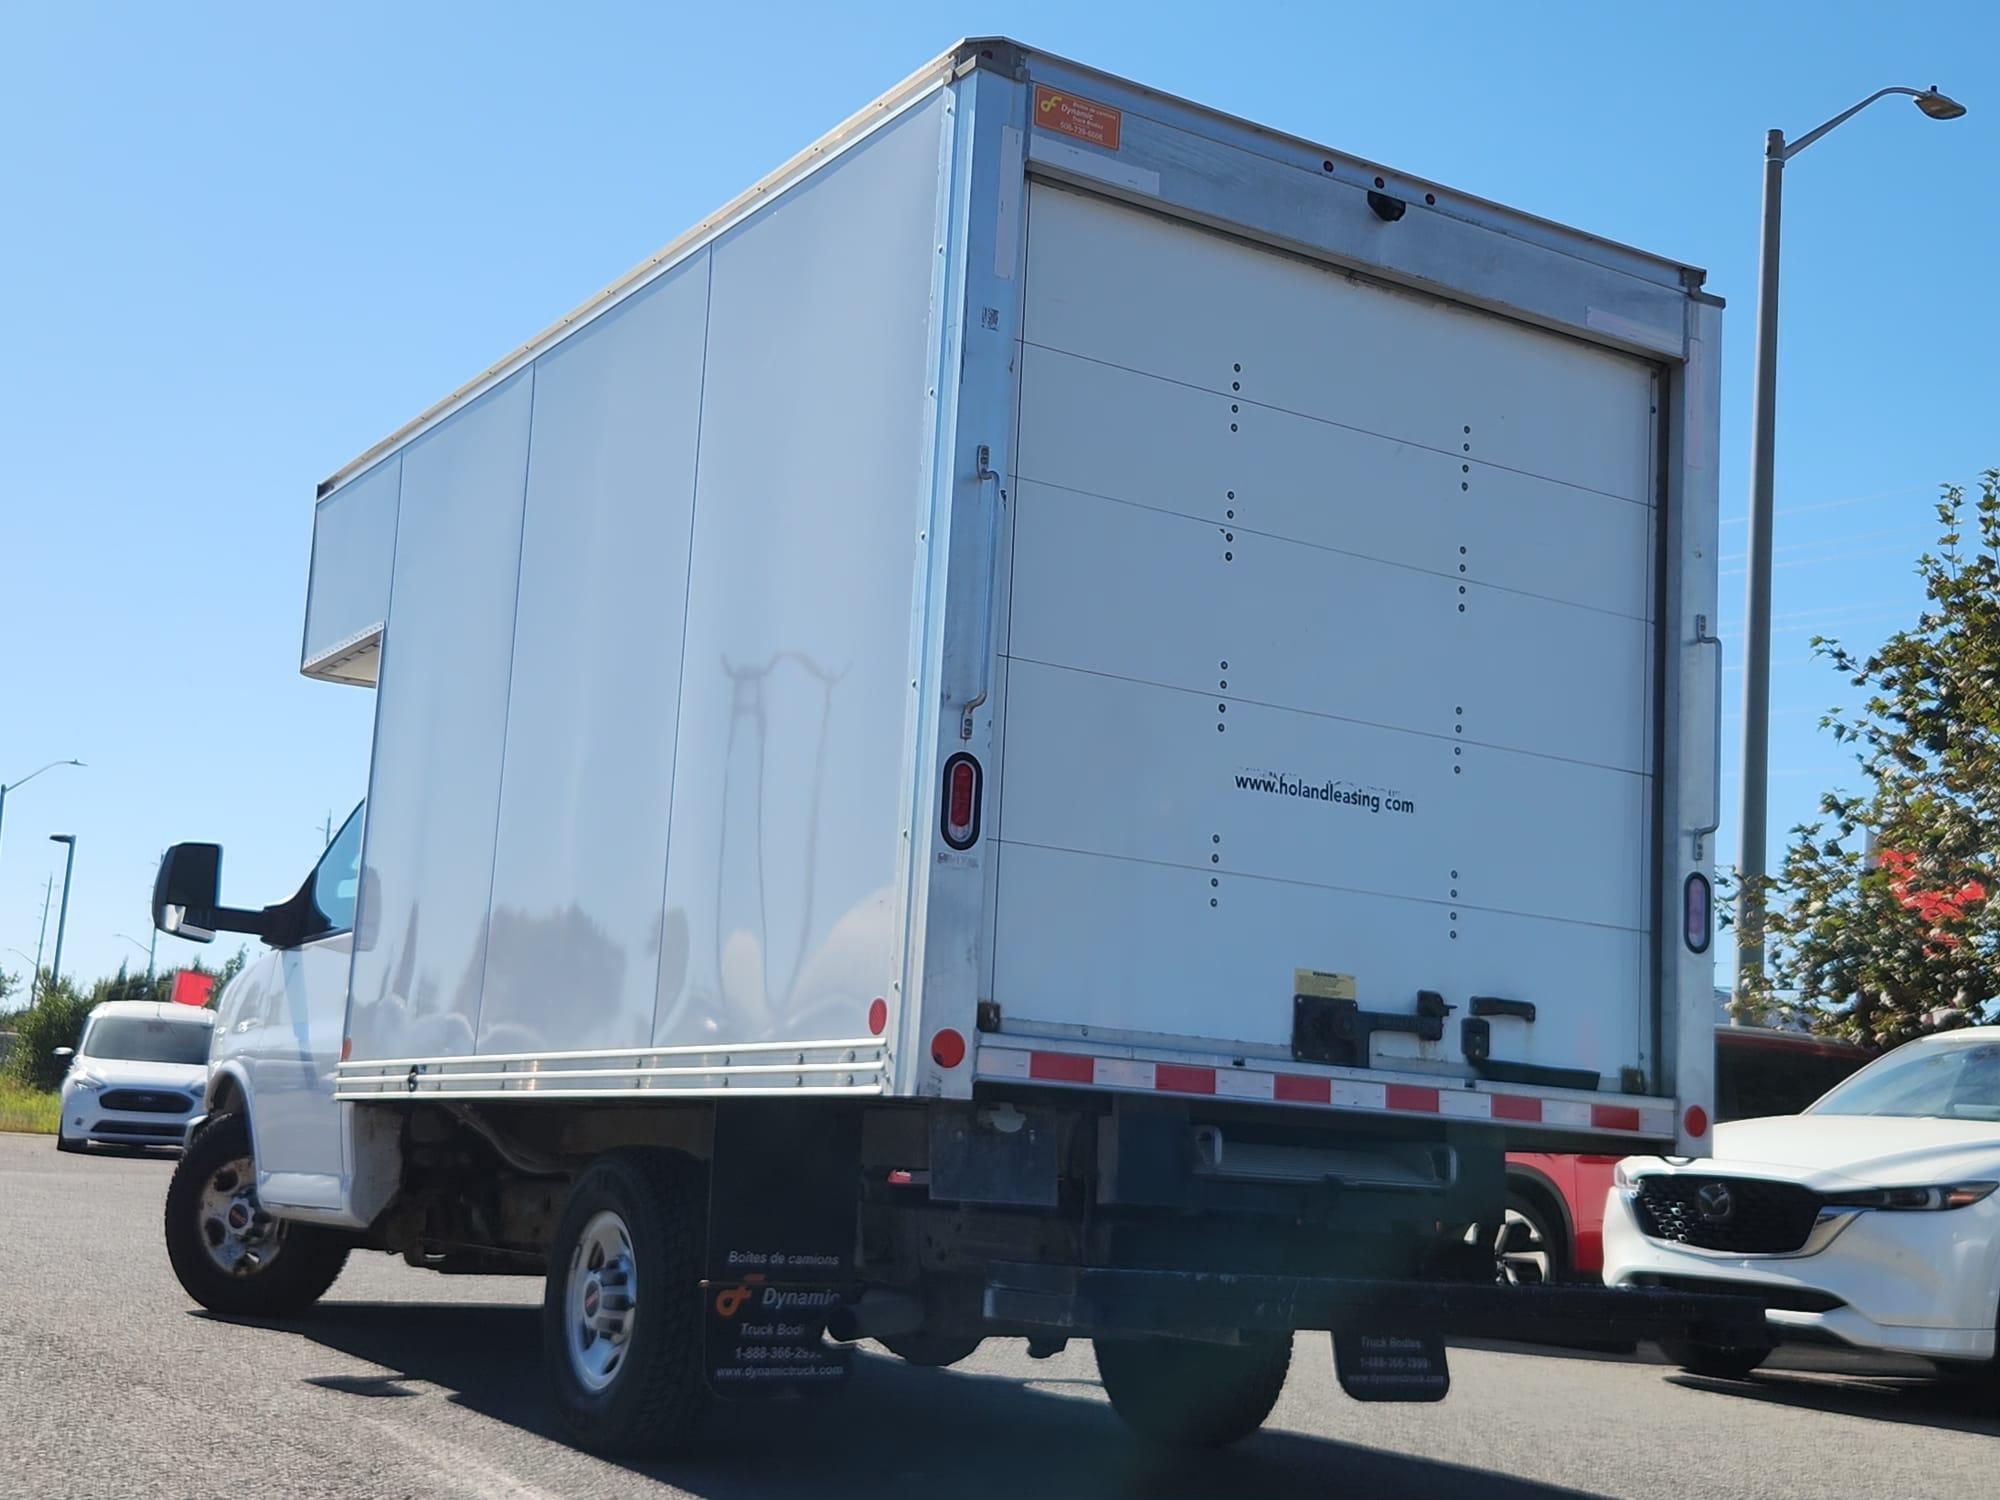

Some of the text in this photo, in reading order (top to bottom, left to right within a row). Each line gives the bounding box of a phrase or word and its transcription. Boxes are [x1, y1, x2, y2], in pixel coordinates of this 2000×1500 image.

[1234, 775, 1414, 813] www.holandleasingcom
[770, 1251, 785, 1264] de
[788, 1252, 840, 1265] camions
[762, 1287, 841, 1309] Dynamic
[741, 1322, 774, 1336] Truck
